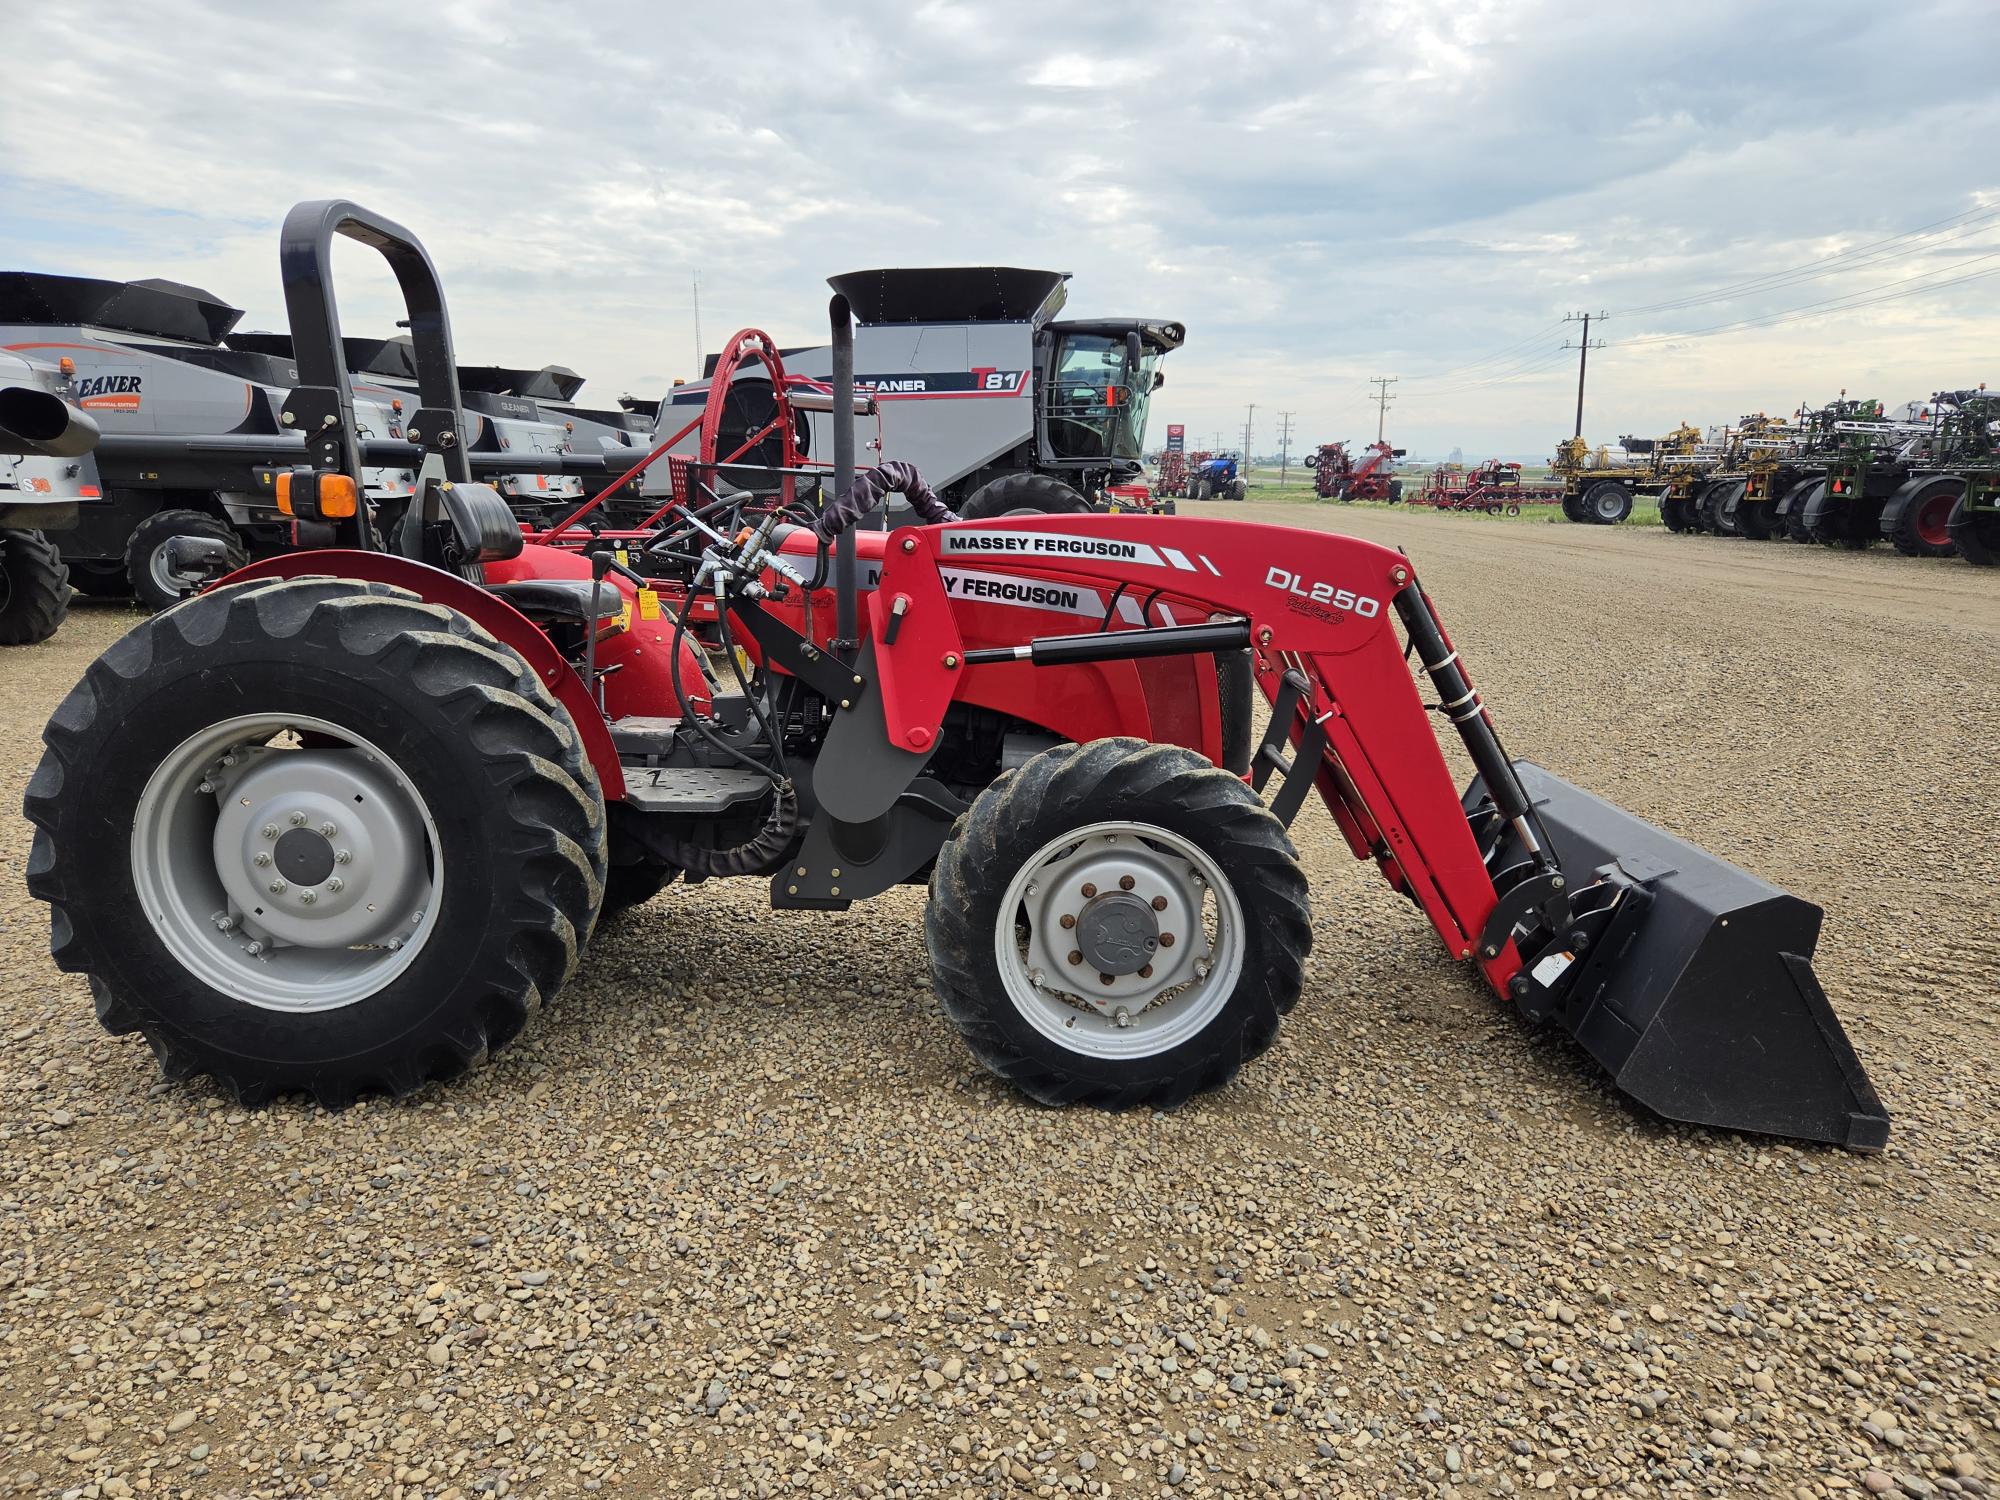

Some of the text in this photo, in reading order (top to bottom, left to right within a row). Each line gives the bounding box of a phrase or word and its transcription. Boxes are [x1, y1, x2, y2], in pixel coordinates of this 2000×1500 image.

[76, 376, 142, 398] EANER
[853, 367, 1017, 393] LEANER T81
[501, 402, 530, 414] GLEANER
[950, 536, 1136, 558] MASSEY FERGUSON
[962, 578, 1079, 609] FERGUSON
[1264, 566, 1380, 618] DL250
